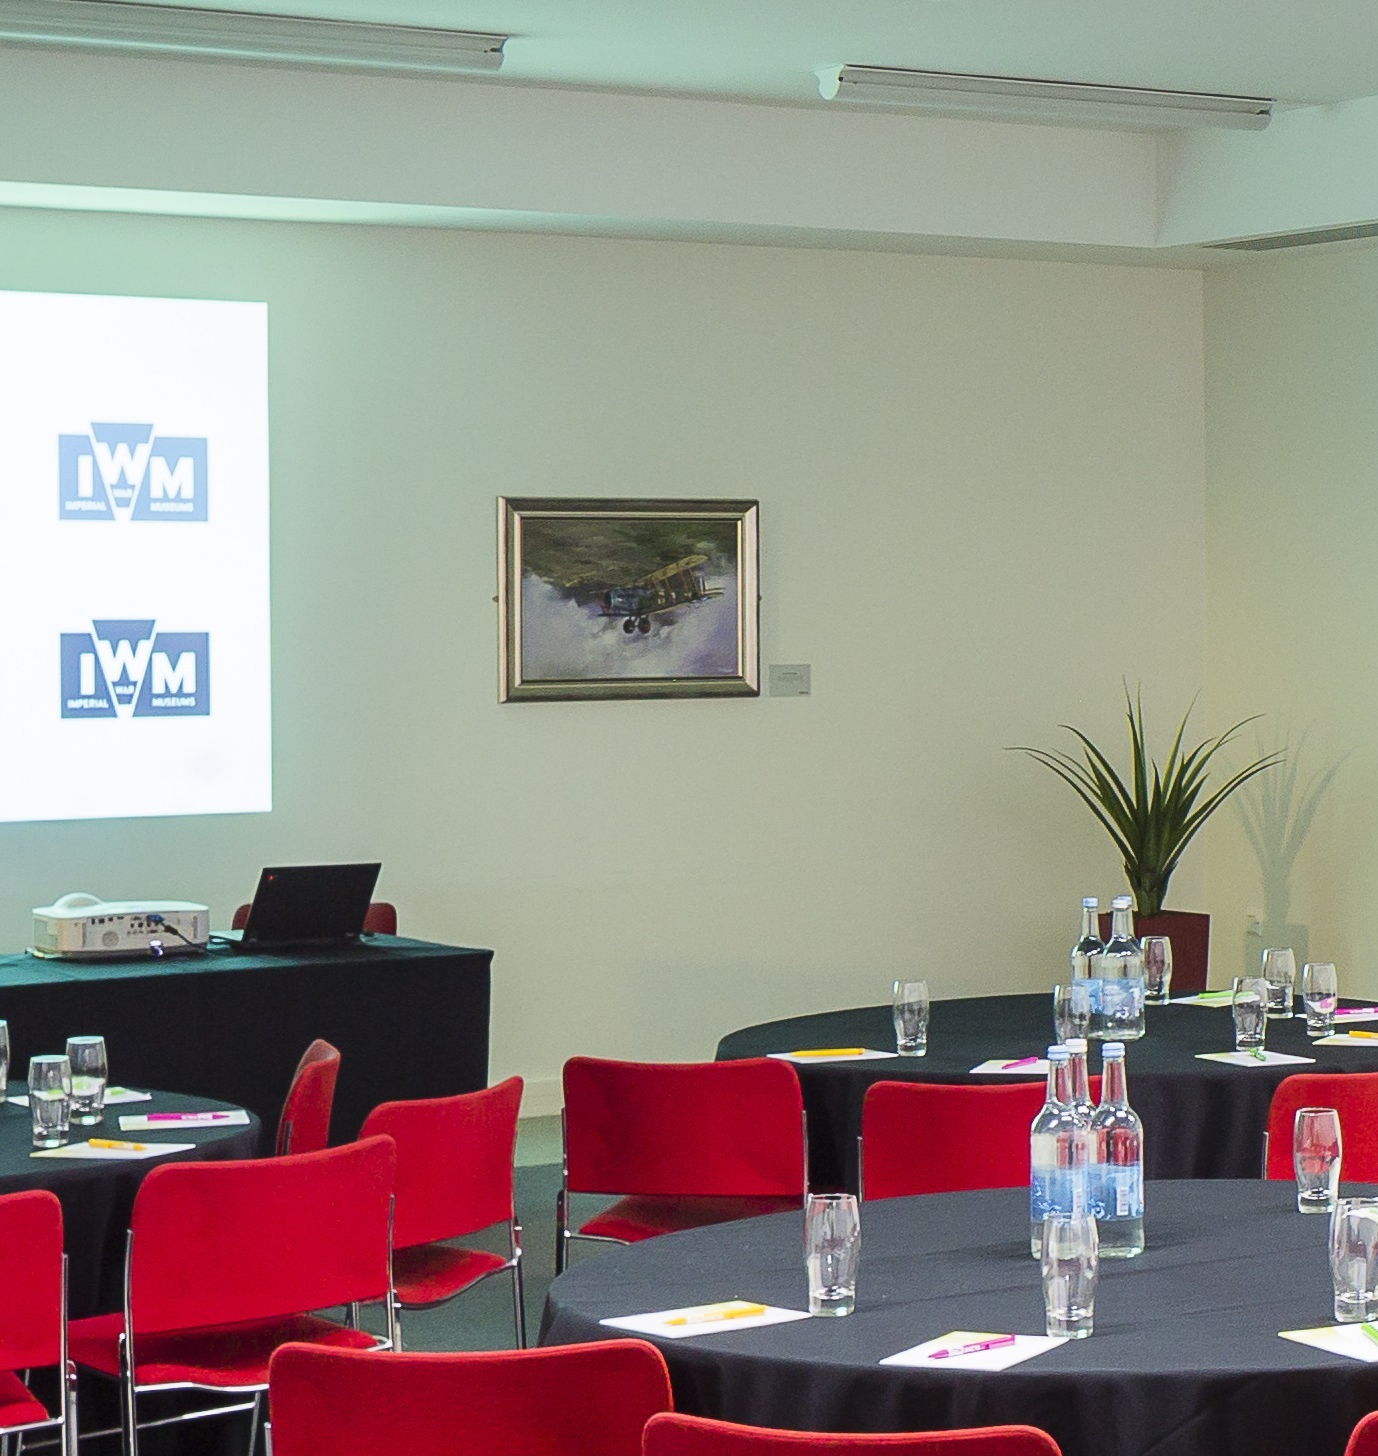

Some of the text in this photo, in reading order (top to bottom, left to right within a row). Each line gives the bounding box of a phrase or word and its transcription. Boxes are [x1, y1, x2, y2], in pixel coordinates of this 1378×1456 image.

[77, 442, 195, 499] IWM
[80, 639, 196, 695] IWM
[67, 698, 109, 709] IMPERIAL
[151, 696, 196, 708] MUSEUMS
